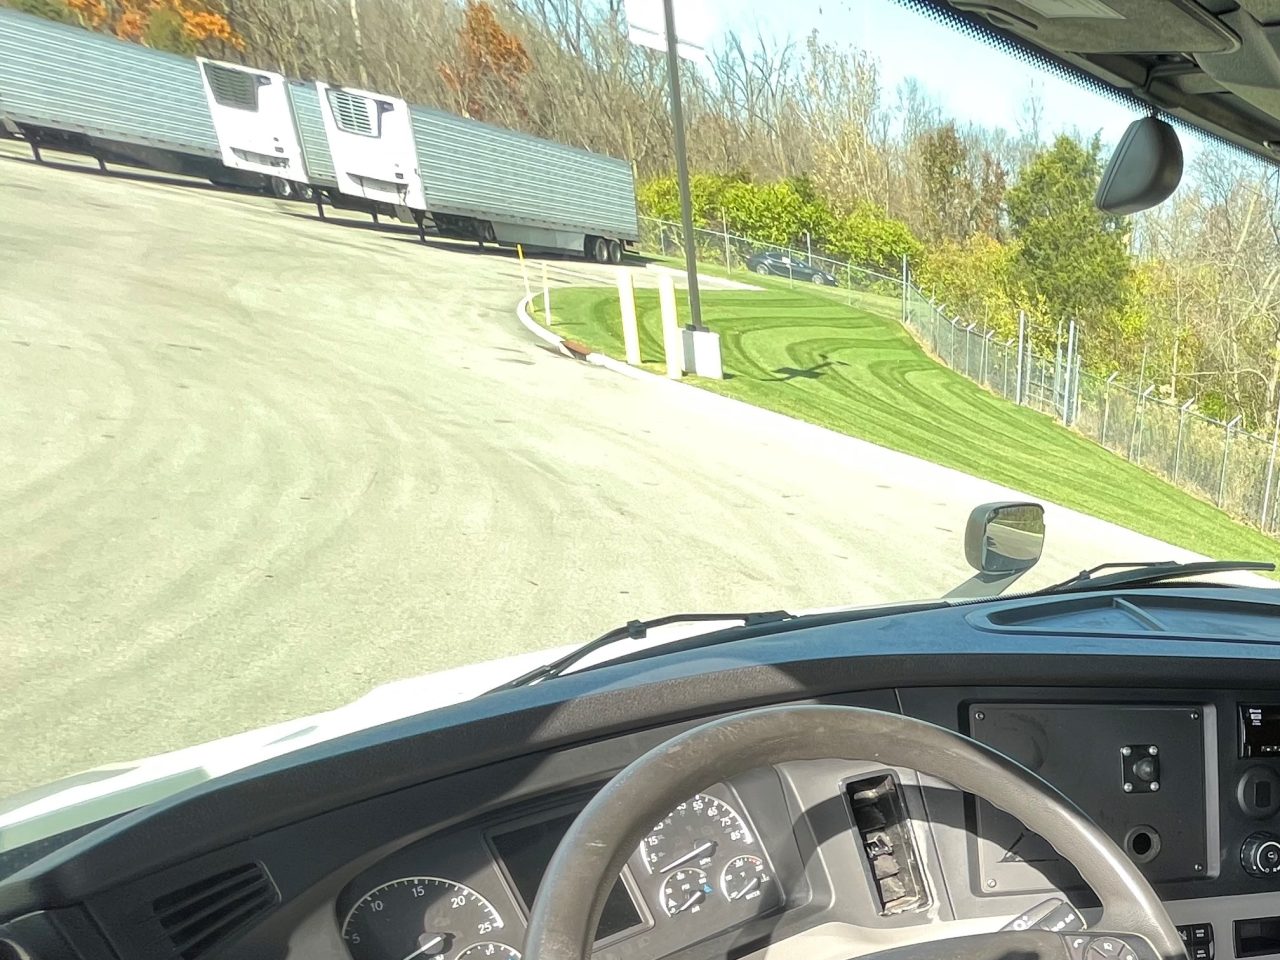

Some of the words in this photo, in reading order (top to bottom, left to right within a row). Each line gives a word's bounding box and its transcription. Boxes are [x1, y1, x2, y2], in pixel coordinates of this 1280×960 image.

[692, 801, 704, 811] 55
[707, 807, 718, 817] 65
[720, 817, 732, 827] 75
[648, 836, 659, 846] 15
[730, 831, 741, 841] 85
[650, 853, 658, 863] 5
[411, 886, 425, 898] 15
[370, 900, 384, 912] 10
[451, 896, 466, 908] 20
[477, 922, 492, 935] 25
[352, 933, 361, 944] 5
